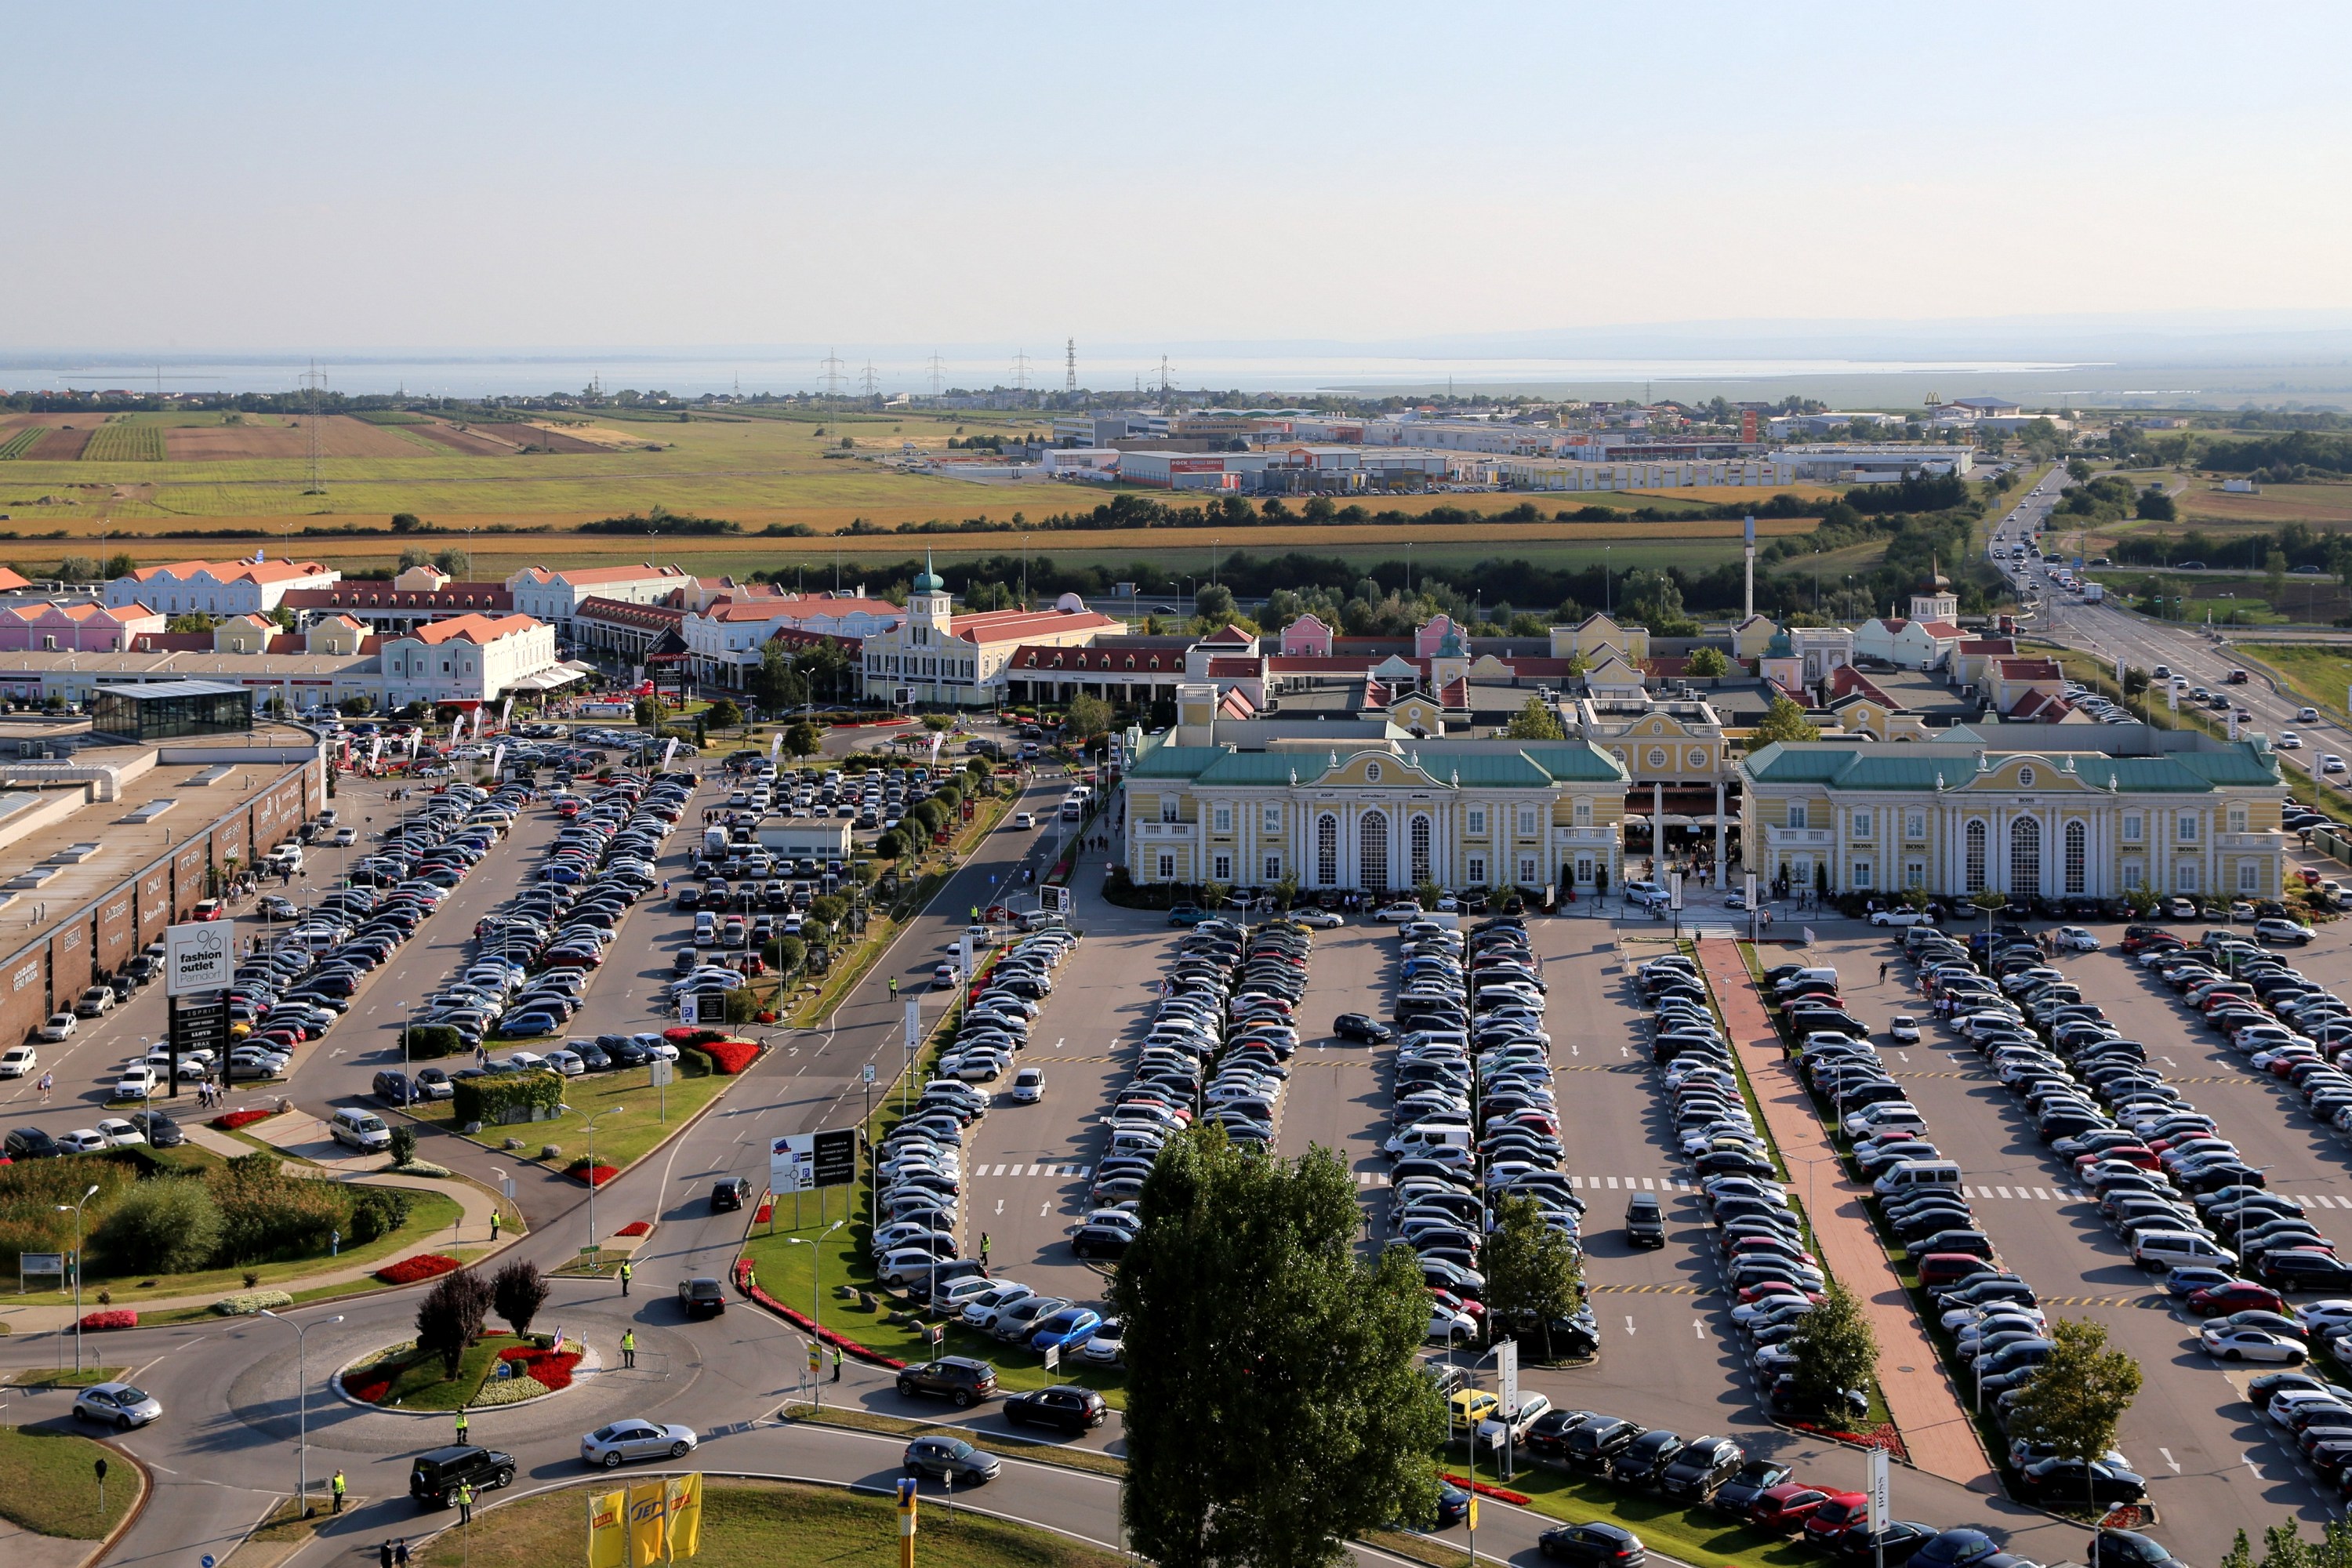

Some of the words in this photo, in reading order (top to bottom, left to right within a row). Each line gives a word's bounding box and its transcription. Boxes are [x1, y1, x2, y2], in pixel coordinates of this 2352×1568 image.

[649, 630, 670, 651] McArthur
[654, 643, 666, 654] Glen
[648, 653, 671, 662] Designer
[180, 855, 191, 871] OTTO
[147, 875, 162, 895] ONLY
[64, 930, 82, 950] ESTELLA
[180, 950, 222, 964] fashion
[180, 960, 214, 973] outlet
[13, 977, 24, 993] VERO
[25, 970, 38, 984] MODA
[180, 970, 221, 982] Parndorf
[187, 1007, 216, 1017] ESPRIT
[633, 1501, 662, 1521] JET
[594, 1514, 612, 1527] BILLA
